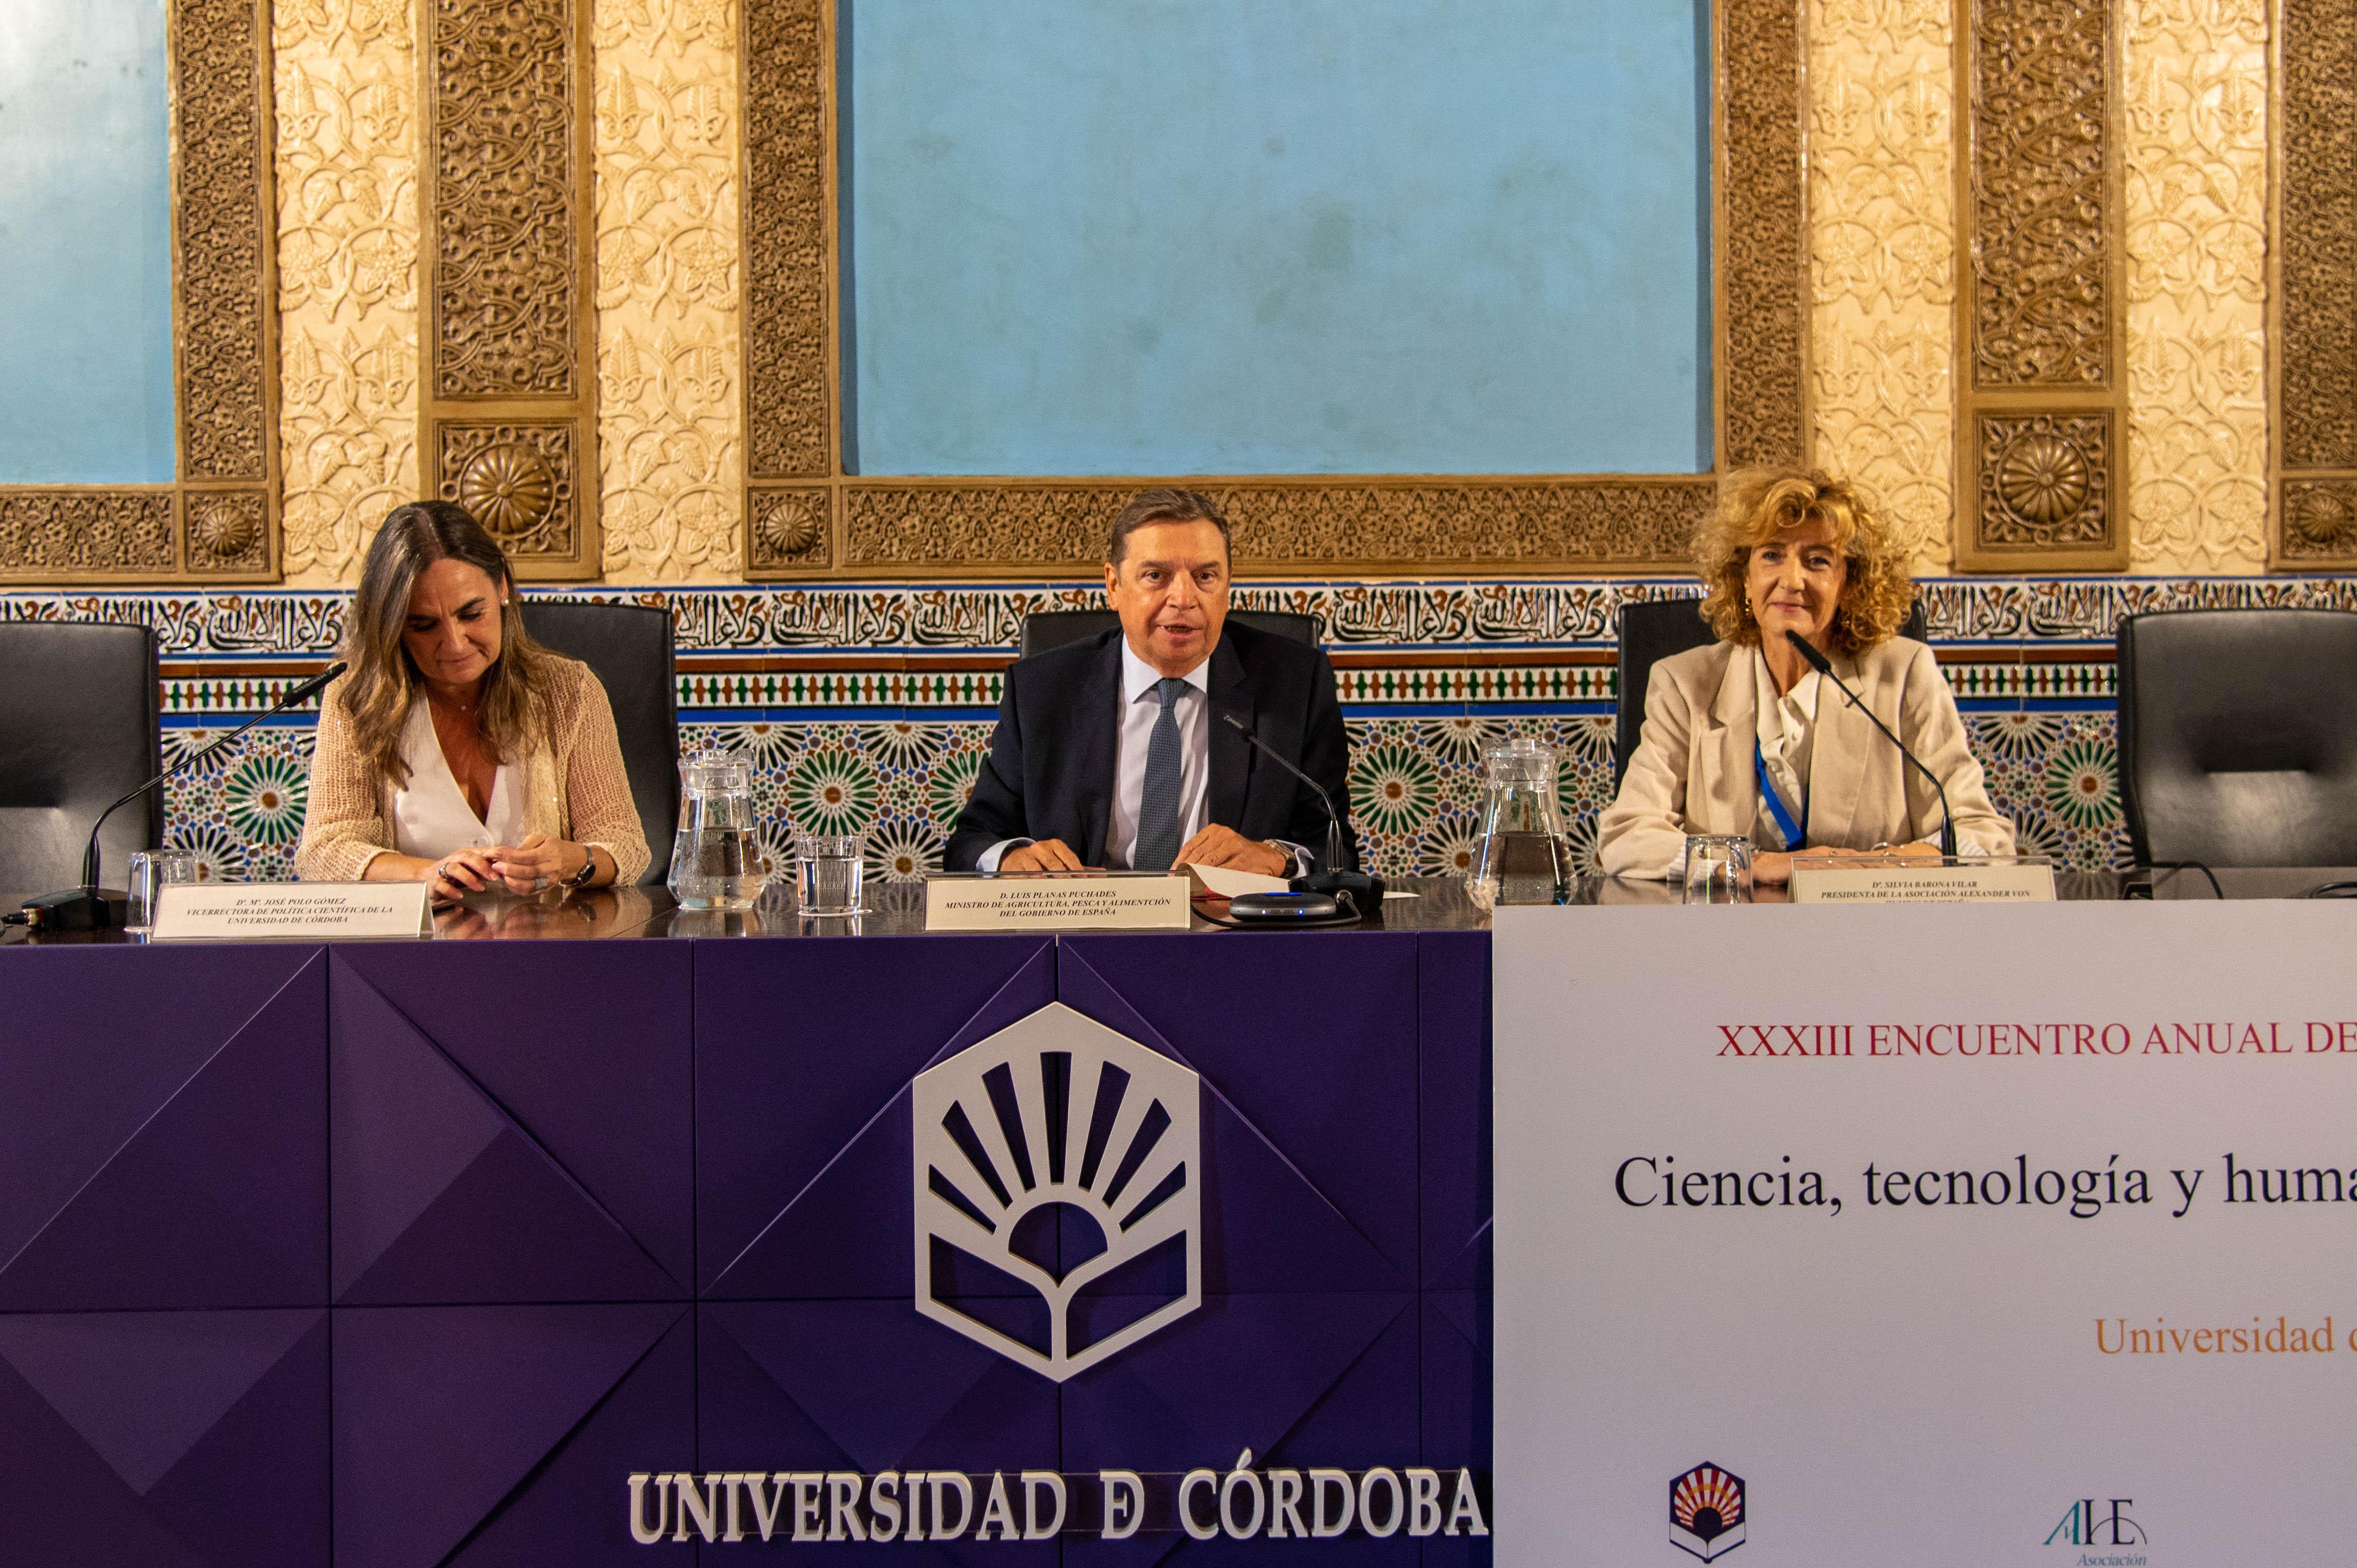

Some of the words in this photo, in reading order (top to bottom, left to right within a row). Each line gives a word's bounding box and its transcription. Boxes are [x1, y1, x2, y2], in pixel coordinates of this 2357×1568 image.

[1903, 889, 1956, 898] ASOCIACIÓN
[264, 897, 287, 906] JOSÉ
[314, 896, 346, 905] GÓMEZ
[1109, 897, 1171, 906] ALIMENTCIÓN
[271, 906, 312, 915] POLÍTICA
[314, 905, 365, 914] CIENTÍFICA
[1082, 907, 1116, 916] ESPAÑA
[305, 915, 349, 923] CÓRDOBA
[1716, 1024, 1856, 1057] XXXIII
[1867, 1023, 2132, 1057] ENCUENTRO
[2141, 1022, 2294, 1055] ANUAL
[2305, 1022, 2357, 1054] DE
[1615, 1155, 1843, 1217] Ciencia,
[1862, 1153, 2154, 1220] tecnología
[2170, 1169, 2205, 1219] y
[2096, 1315, 2335, 1354] Universidad
[627, 1470, 1067, 1544] UNIVERSIDAD
[1178, 1447, 1489, 1540] CÓRDOBA
[2078, 1554, 2147, 1566] Asociación
